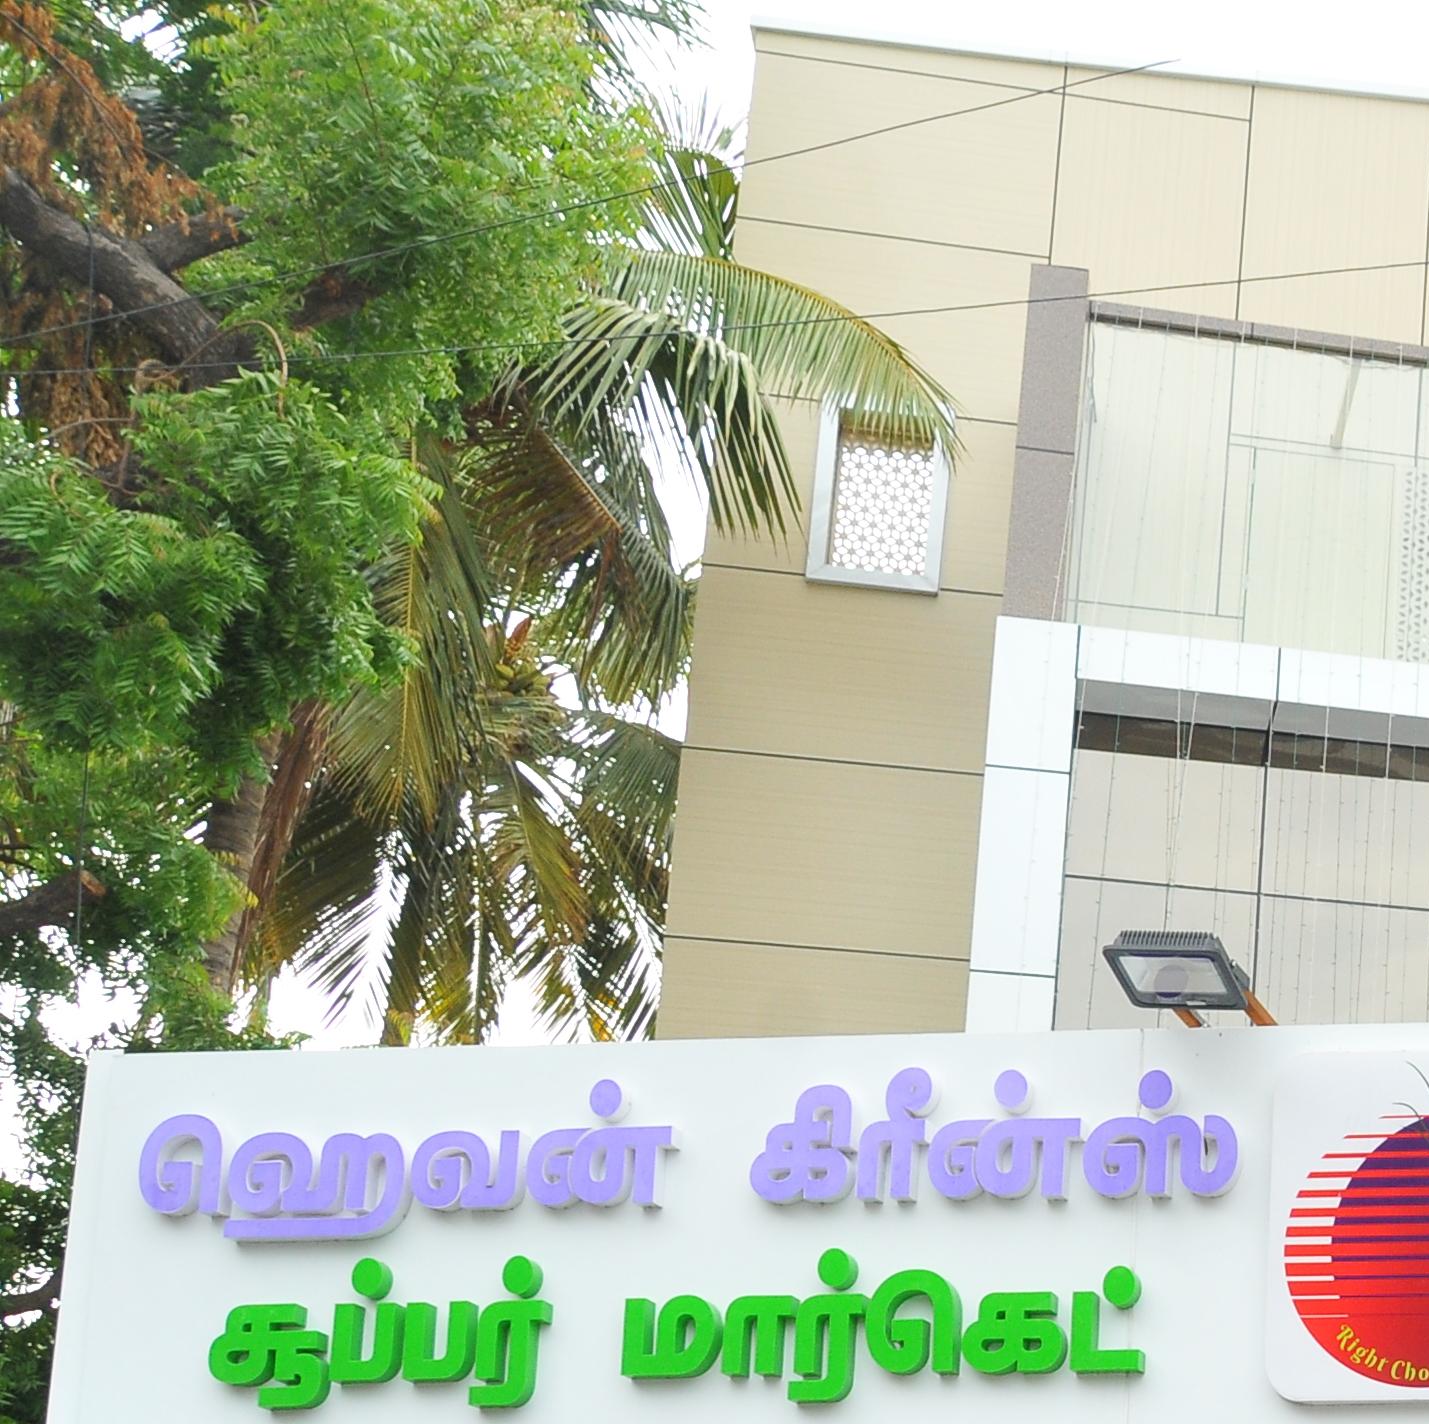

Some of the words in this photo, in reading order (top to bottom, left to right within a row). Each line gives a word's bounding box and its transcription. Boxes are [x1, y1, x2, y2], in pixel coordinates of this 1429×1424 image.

[207, 1256, 552, 1412] சூப்பர்
[621, 1246, 1146, 1405] மார்கெட்
[1336, 1324, 1389, 1372] Right
